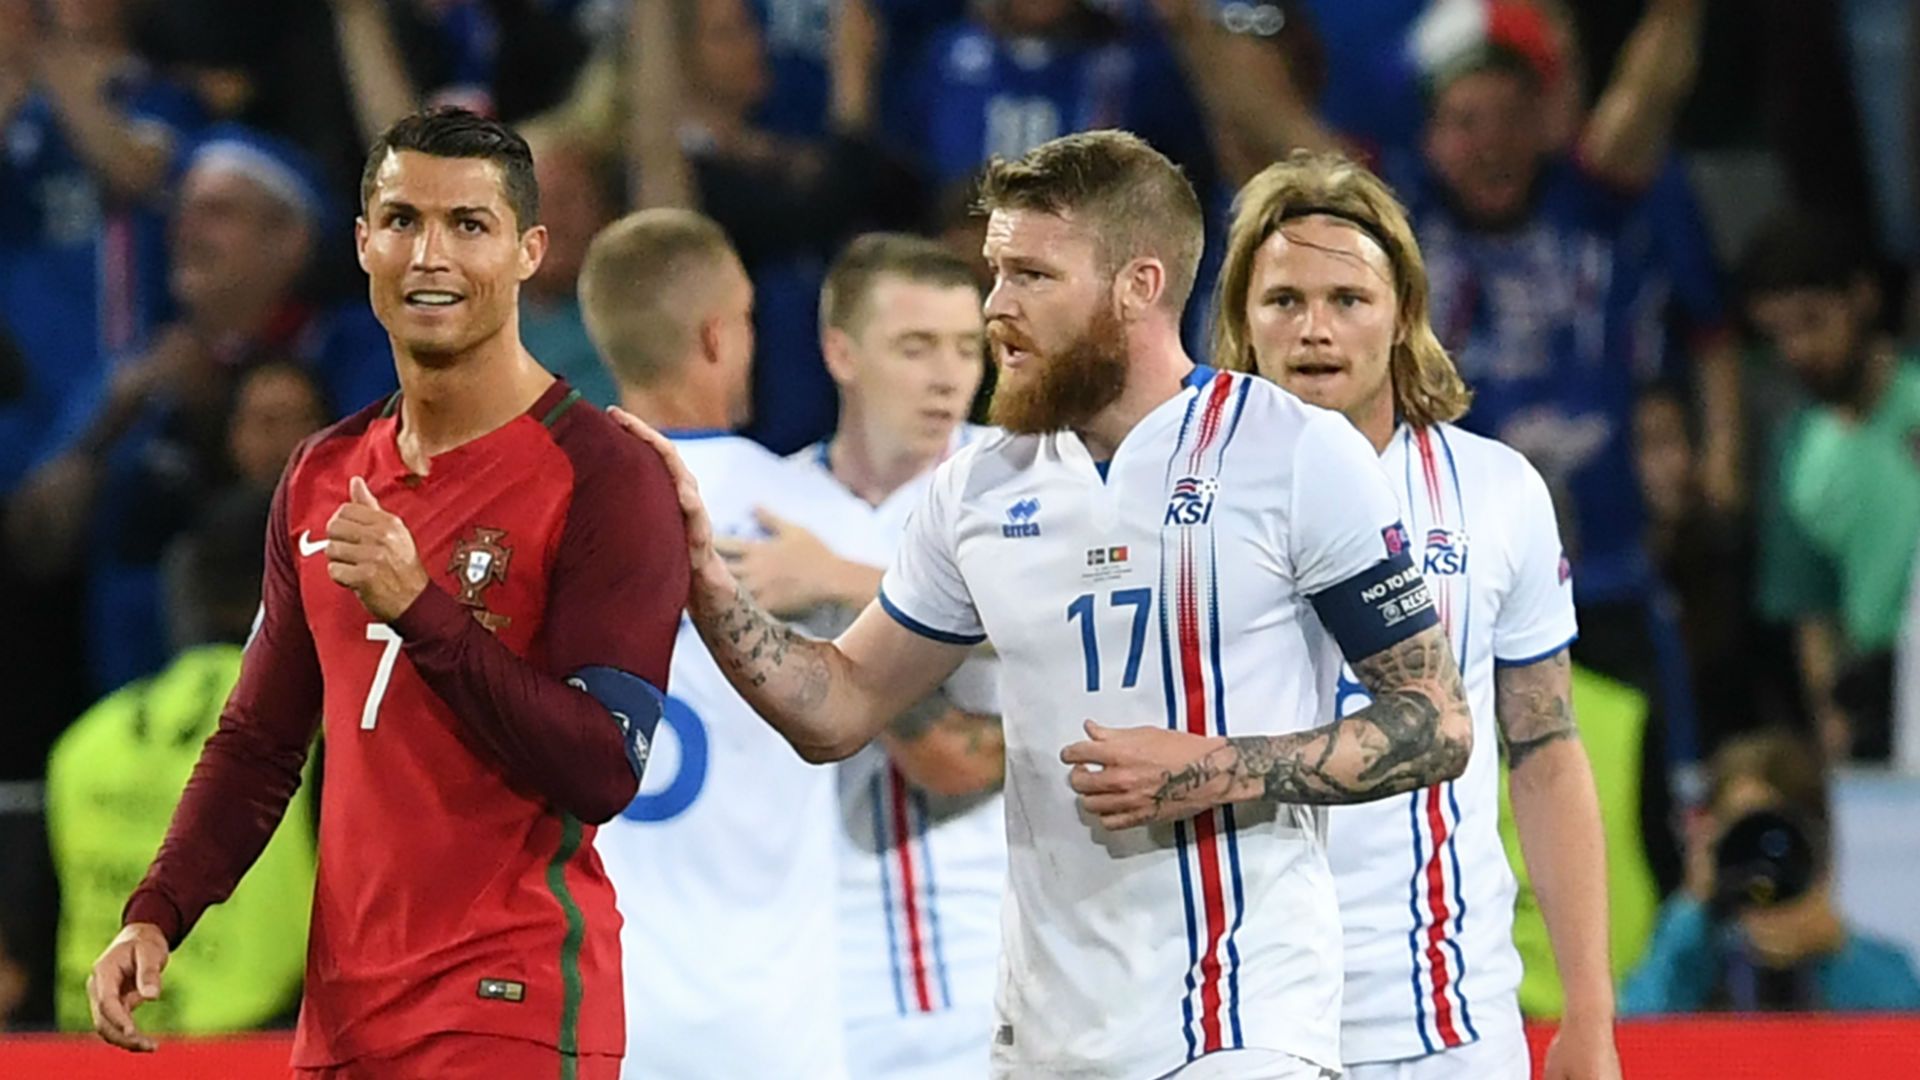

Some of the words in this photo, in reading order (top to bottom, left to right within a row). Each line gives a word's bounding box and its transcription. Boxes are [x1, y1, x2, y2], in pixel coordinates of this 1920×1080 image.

[1066, 586, 1152, 692] 17
[1361, 583, 1387, 603] NO
[1384, 574, 1404, 590] TO
[361, 623, 403, 729] 7
